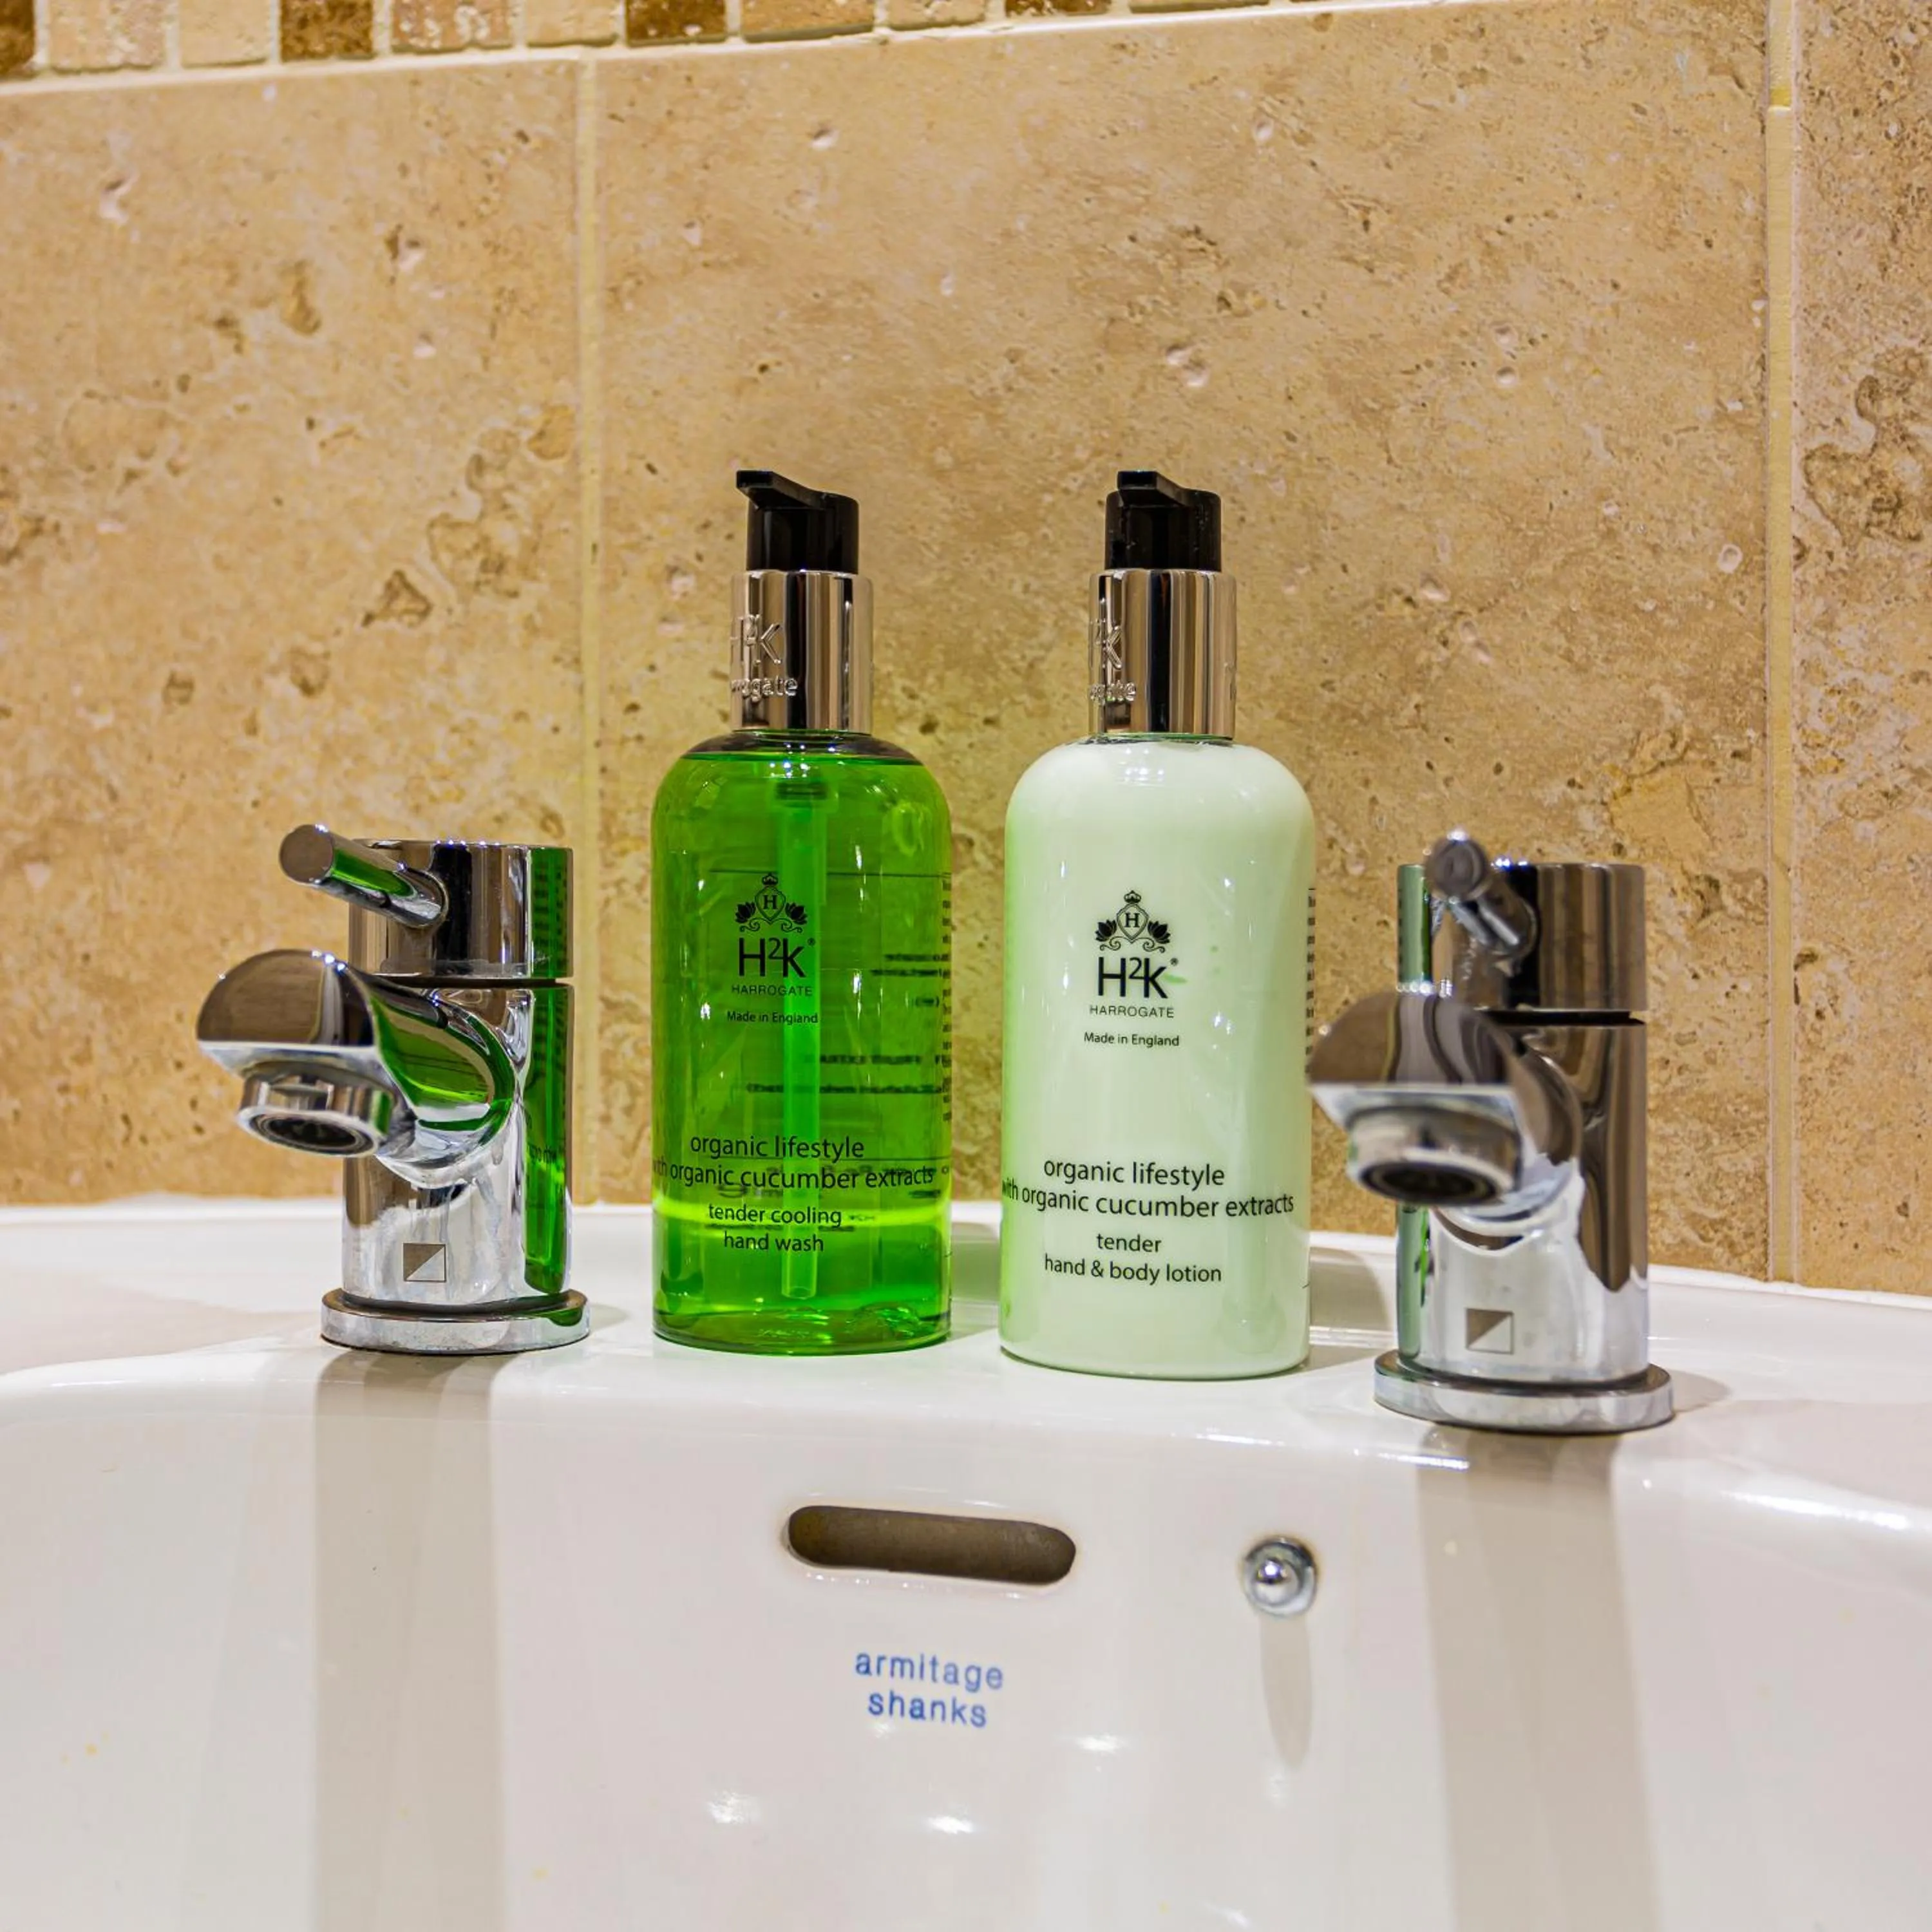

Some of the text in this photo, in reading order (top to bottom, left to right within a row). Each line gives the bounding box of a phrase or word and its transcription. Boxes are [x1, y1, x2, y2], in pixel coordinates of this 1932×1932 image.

[1125, 913, 1140, 928] H
[732, 984, 813, 996] HARROGATE
[727, 1010, 818, 1025] Made in England
[1090, 1005, 1174, 1018] HARROGATE
[1084, 1032, 1179, 1048] Made in England
[690, 1136, 864, 1163] organic lifestyle
[670, 1164, 734, 1186] organic
[741, 1166, 859, 1189] cucumber
[866, 1165, 933, 1188] extracts
[1044, 1160, 1224, 1191] organic lifestyle
[1022, 1187, 1088, 1211] organic
[1096, 1195, 1218, 1217] cucumber
[1226, 1193, 1294, 1217] extracts
[708, 1204, 842, 1227] tender cooling
[724, 1231, 824, 1251] hand wash
[1096, 1233, 1162, 1253] tender
[1045, 1253, 1222, 1285] hand & body lotion
[855, 1653, 1003, 1693] armitage
[868, 1689, 987, 1728] shanks
